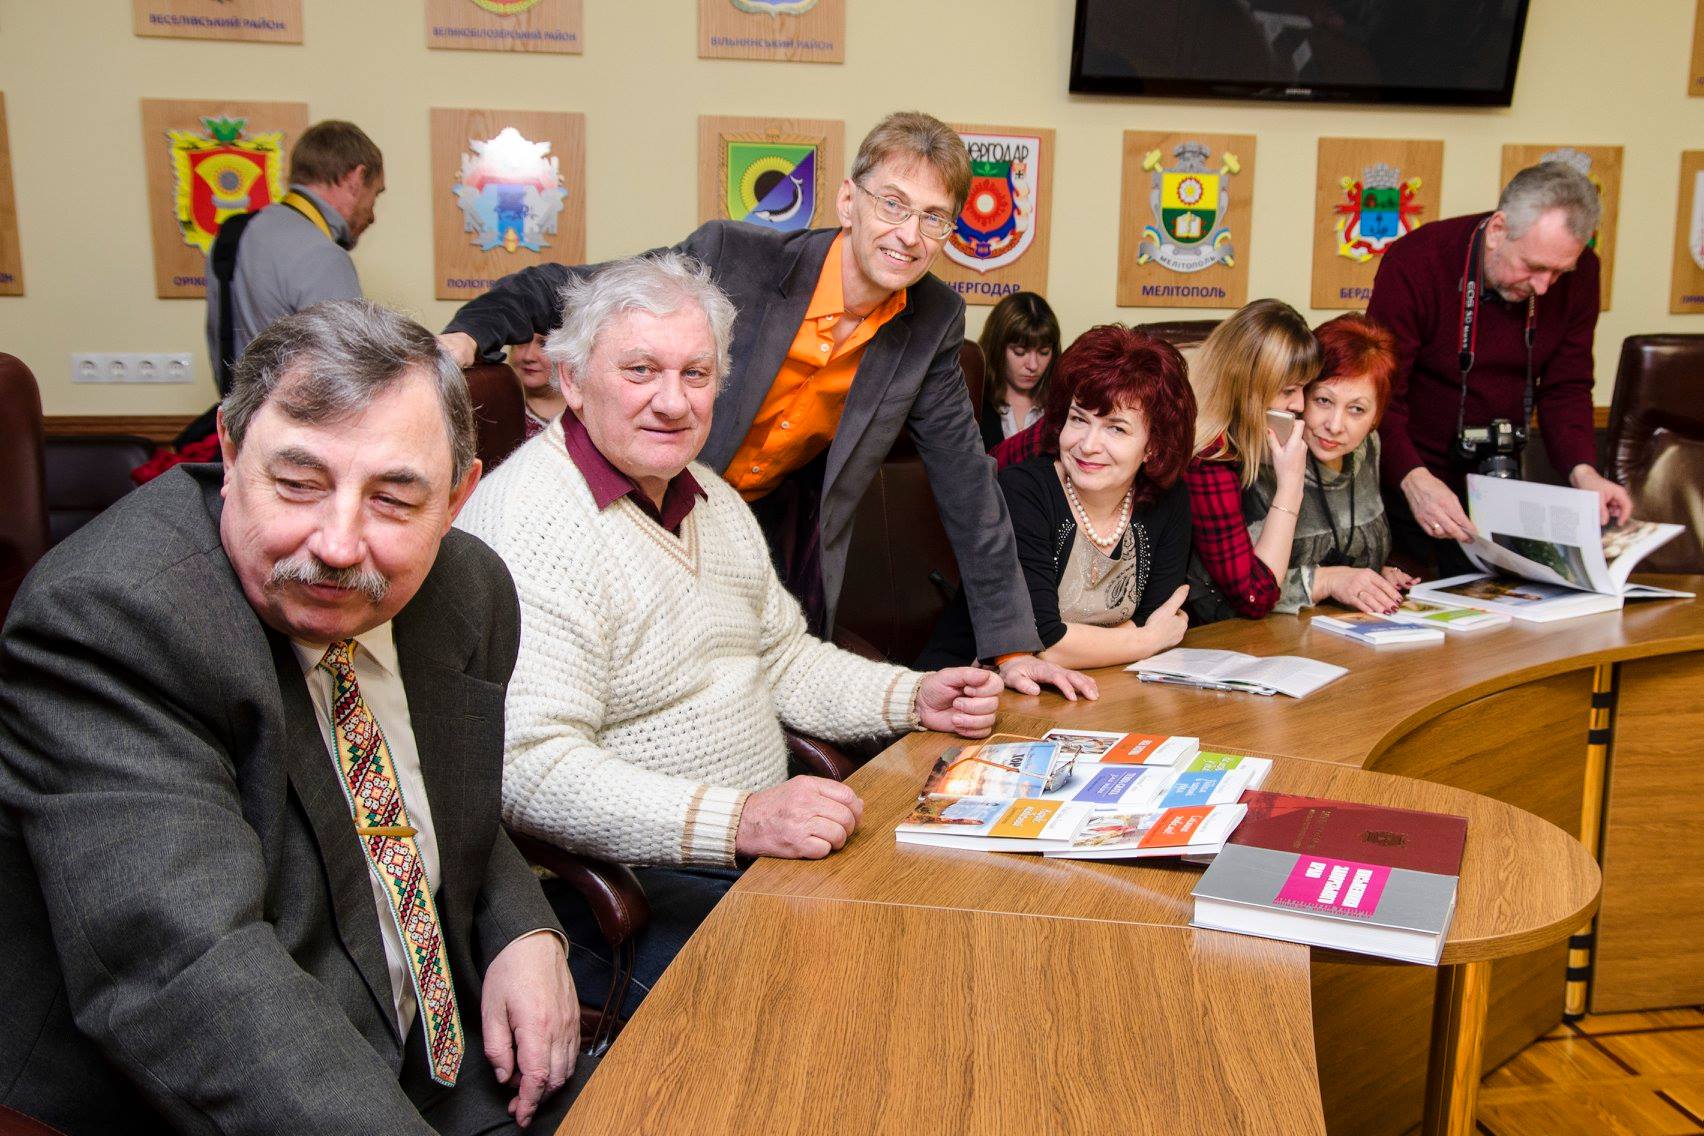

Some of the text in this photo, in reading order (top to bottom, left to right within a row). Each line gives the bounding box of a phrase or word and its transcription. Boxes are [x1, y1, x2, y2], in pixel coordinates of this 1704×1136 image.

[544, 29, 576, 41] РАЙОН
[797, 39, 833, 50] РАЙОН
[1160, 255, 1217, 269] МЕЛІТОПОЛЬ
[1142, 285, 1226, 298] МЕЛІТОПОЛЬ
[1466, 281, 1475, 308] EOS
